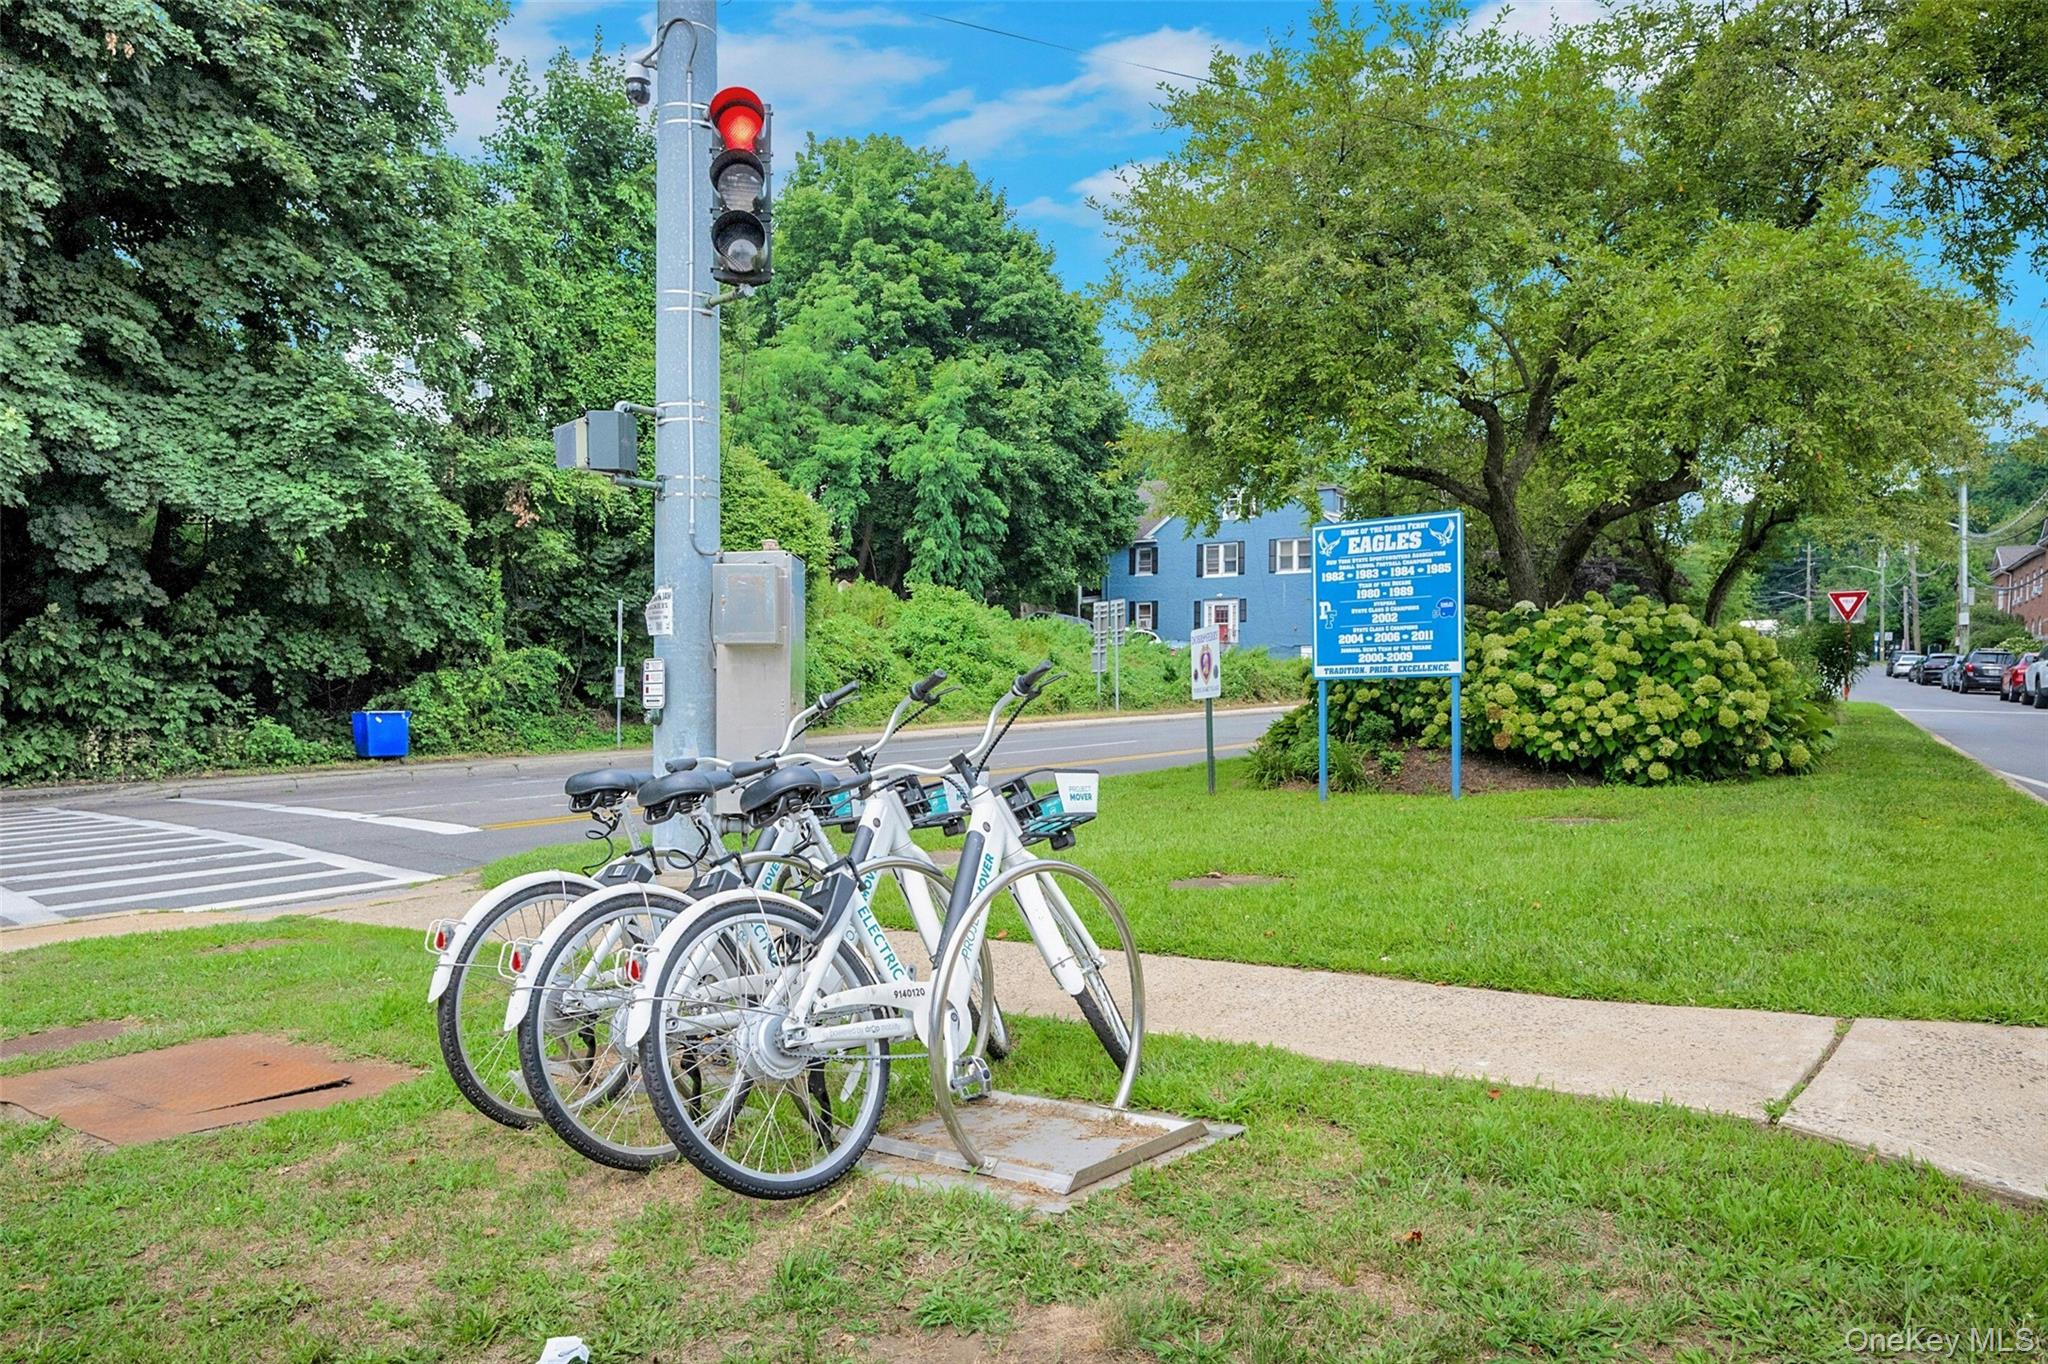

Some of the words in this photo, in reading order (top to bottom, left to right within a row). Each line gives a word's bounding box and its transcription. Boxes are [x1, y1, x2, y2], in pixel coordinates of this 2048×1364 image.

[1384, 524, 1406, 532] DOBBS
[1408, 521, 1430, 530] FERRY
[1347, 531, 1422, 554] EAGLES
[1322, 571, 1345, 582] 1982
[1356, 569, 1379, 580] 1983
[1390, 566, 1415, 577] 1984
[1426, 562, 1452, 574] 1985
[1356, 588, 1380, 599] 1980
[1389, 586, 1414, 597] 1989
[1372, 613, 1398, 624] 2002
[1338, 634, 1364, 644] 2004
[1374, 632, 1400, 643] 2006
[1411, 630, 1434, 641] 2011
[1358, 651, 1413, 663] 2000-2009
[858, 906, 904, 980] ELECTRIC
[894, 988, 925, 998] 9140120
